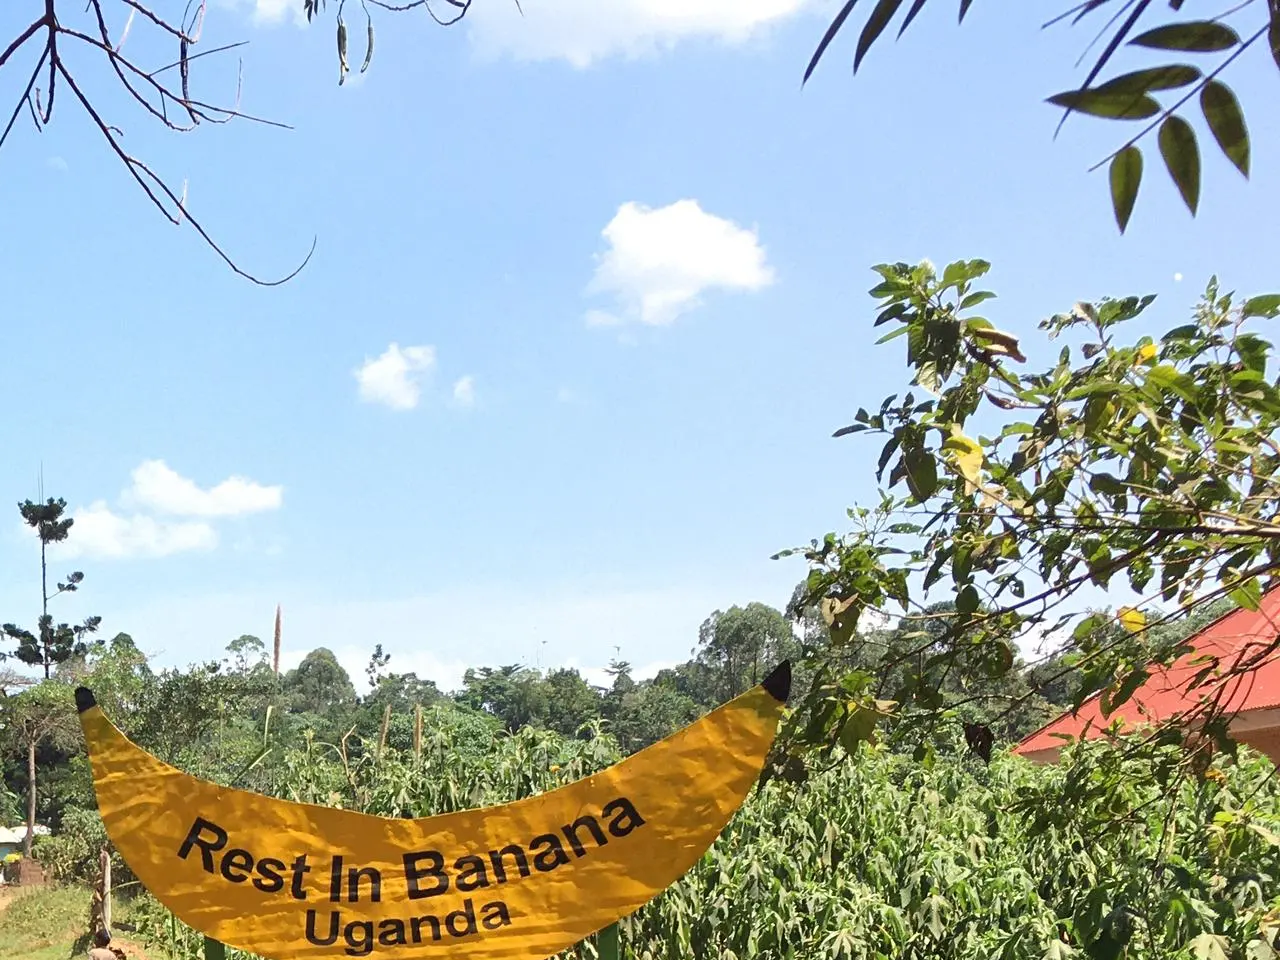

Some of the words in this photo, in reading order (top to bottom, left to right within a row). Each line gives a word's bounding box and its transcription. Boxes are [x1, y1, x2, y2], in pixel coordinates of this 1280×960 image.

[177, 816, 311, 900] Rest
[330, 855, 382, 903] In
[402, 797, 646, 900] Banana
[305, 898, 512, 957] Uganda
